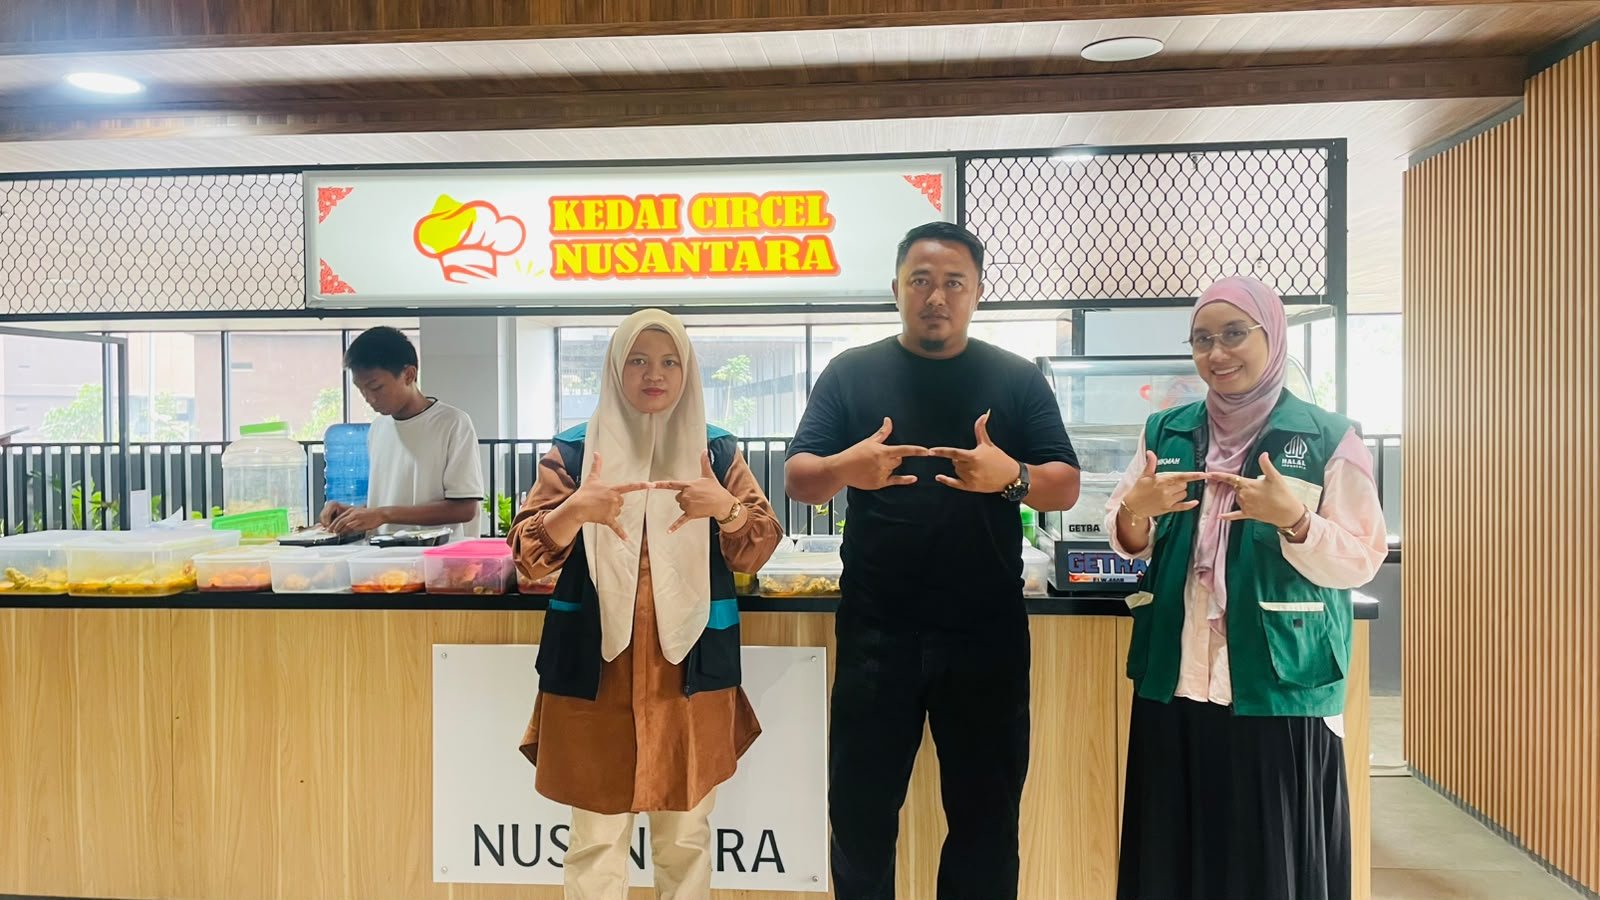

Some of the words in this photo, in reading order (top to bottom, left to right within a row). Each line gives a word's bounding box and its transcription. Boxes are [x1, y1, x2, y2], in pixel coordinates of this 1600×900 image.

[551, 196, 680, 233] KEDAI
[690, 192, 832, 231] CIRCEL
[552, 237, 837, 276] NUSANTARA
